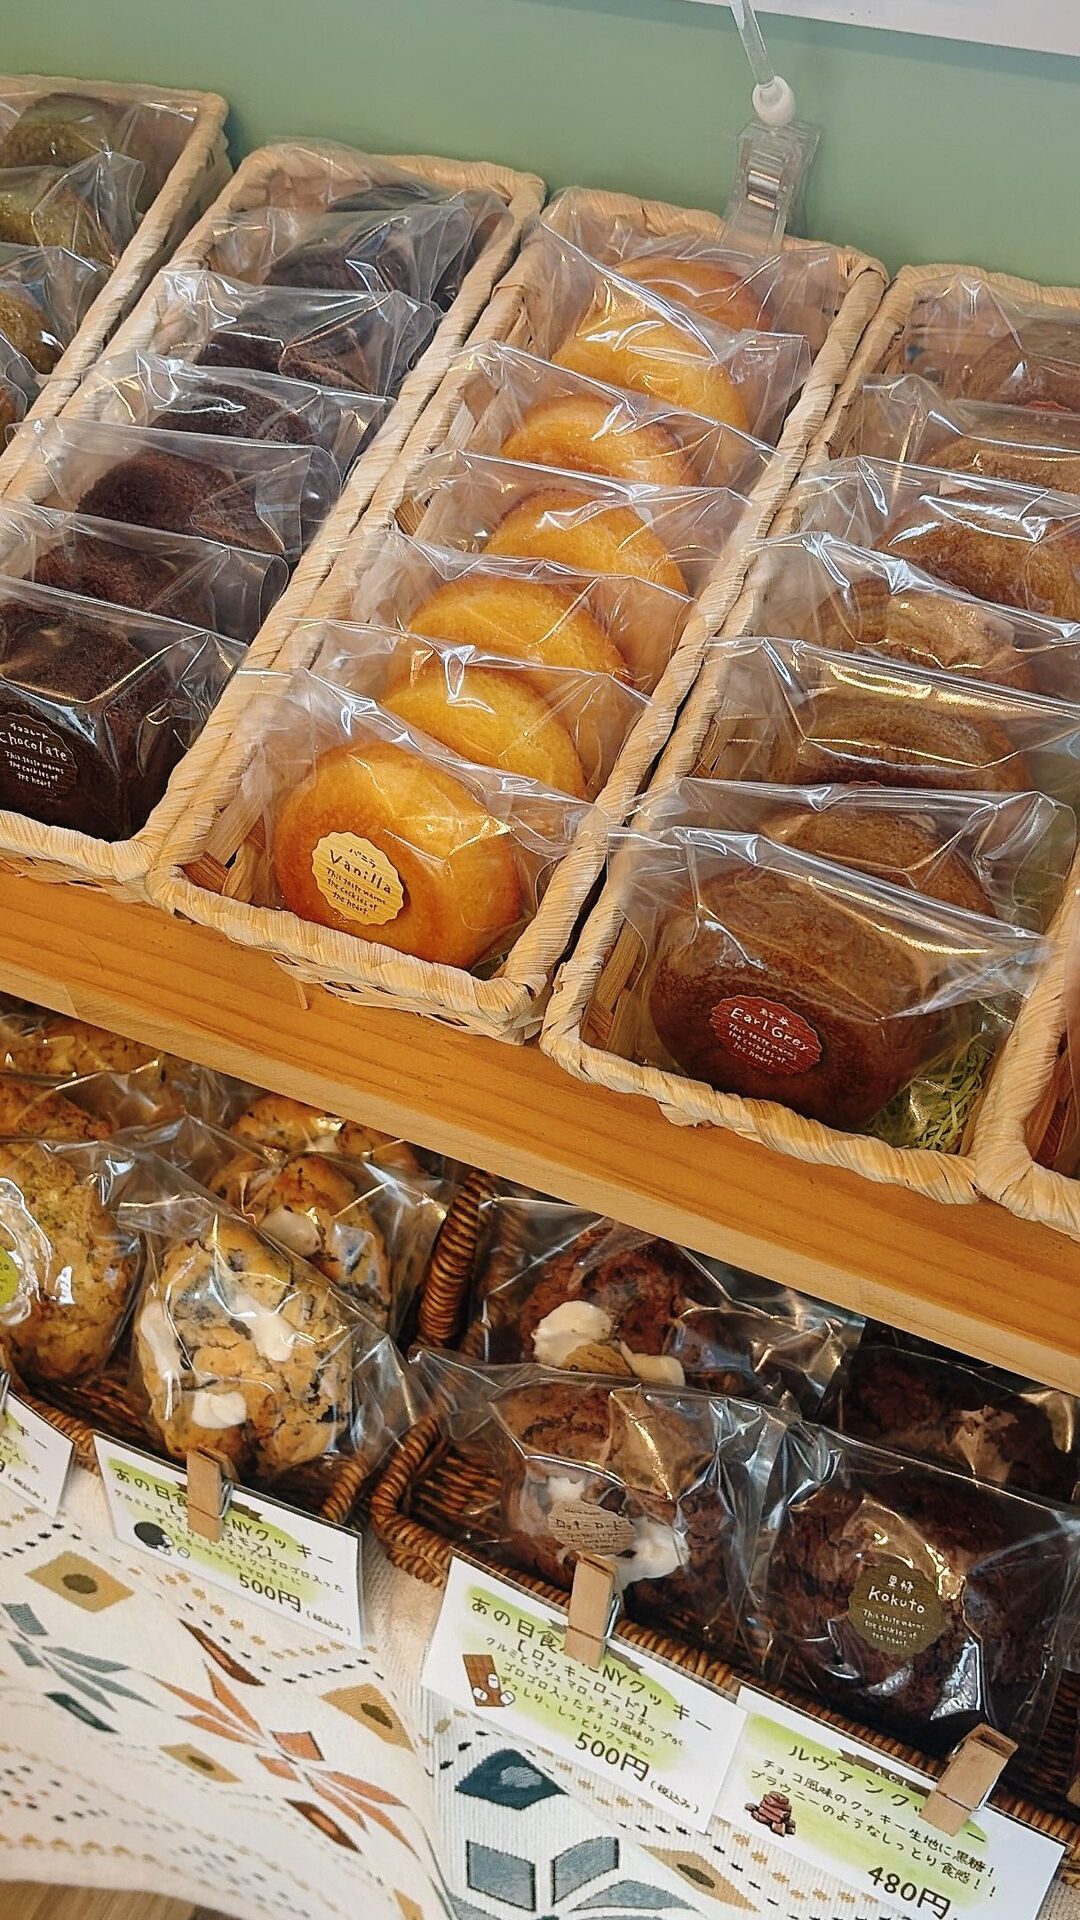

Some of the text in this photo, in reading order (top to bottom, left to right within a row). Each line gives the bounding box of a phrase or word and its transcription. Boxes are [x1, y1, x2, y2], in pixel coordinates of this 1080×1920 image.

[5, 750, 21, 761] This
[329, 849, 391, 894] Vanilla
[349, 848, 376, 868] バニラ
[326, 867, 342, 881] This
[332, 891, 345, 903] the
[728, 1022, 746, 1035] This
[730, 1006, 809, 1052] Earl Grey
[239, 1574, 301, 1613] 500円
[867, 1585, 926, 1614] Kokuto
[862, 1608, 879, 1620] This
[472, 1596, 712, 1731] あの日食NYクッキー
[574, 1731, 650, 1782] 500円
[867, 1866, 952, 1920] 480円
